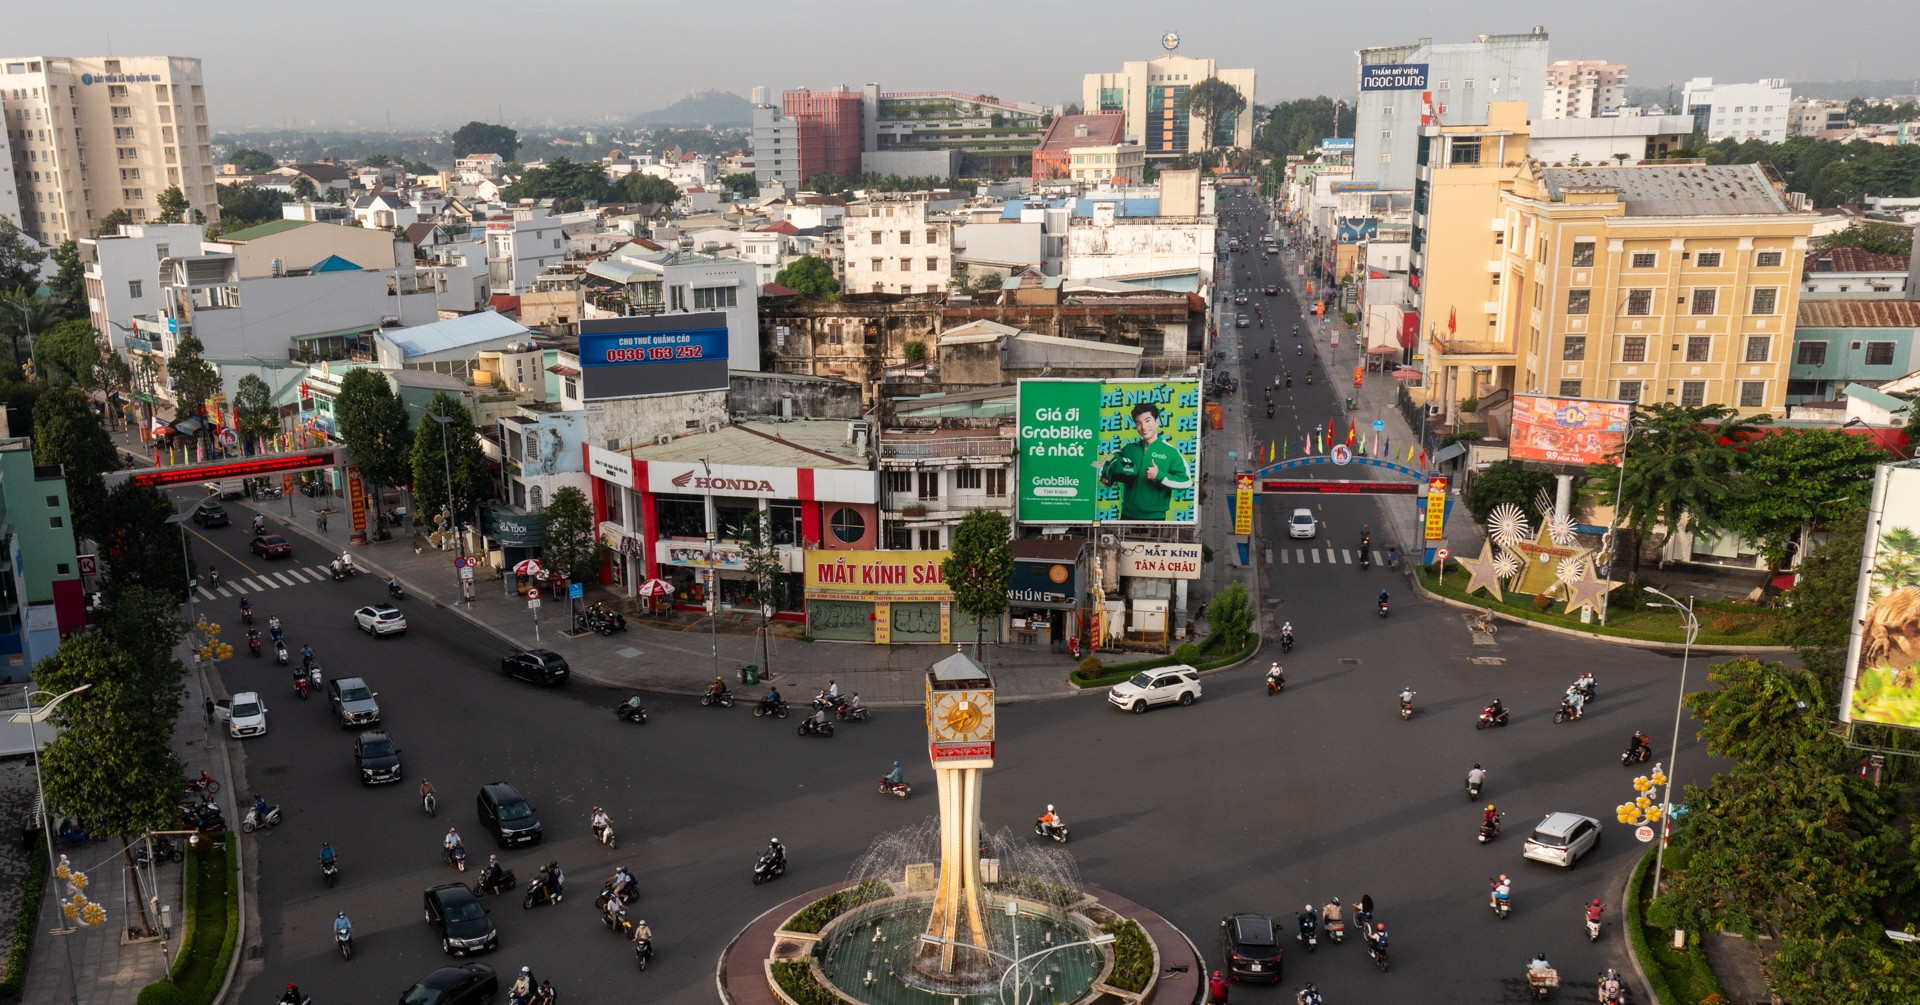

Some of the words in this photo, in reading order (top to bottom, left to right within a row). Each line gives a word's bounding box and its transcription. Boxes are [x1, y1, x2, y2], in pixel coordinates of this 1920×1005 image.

[1371, 66, 1392, 75] THẨM
[1392, 67, 1403, 75] MỸ
[1403, 66, 1419, 75] VIỆN
[1364, 76, 1393, 88] NGỌC
[1395, 76, 1425, 87] DUNG
[618, 338, 633, 346] CHO
[634, 336, 652, 345] THUÊ
[653, 334, 676, 345] QUẢNG
[677, 333, 691, 343] CÁO
[606, 347, 645, 362] 0936
[647, 346, 673, 360] 163
[675, 345, 703, 358] 252
[1100, 386, 1123, 408] RẺ
[1124, 383, 1175, 406] NHẤT
[1178, 386, 1199, 408] RẺ
[1035, 407, 1062, 421] Giá
[1064, 407, 1080, 421] đi
[1099, 410, 1122, 432] RẺ
[1176, 410, 1198, 432] RẺ
[1021, 425, 1093, 439] GrabBike
[1029, 441, 1045, 456] rẻ
[1098, 434, 1121, 456] RẺ
[1175, 434, 1197, 455] RẺ
[1151, 452, 1167, 460] Grab
[694, 477, 775, 492] HONDA
[1032, 475, 1080, 486] GrabBike
[1170, 548, 1198, 558] KÍNH
[817, 556, 857, 584] MẮT
[861, 560, 907, 585] KÍNH
[1134, 559, 1156, 571] TÂN
[1157, 559, 1166, 571] Á
[1167, 560, 1196, 572] CHÂU
[1006, 587, 1051, 602] NHÚNG
